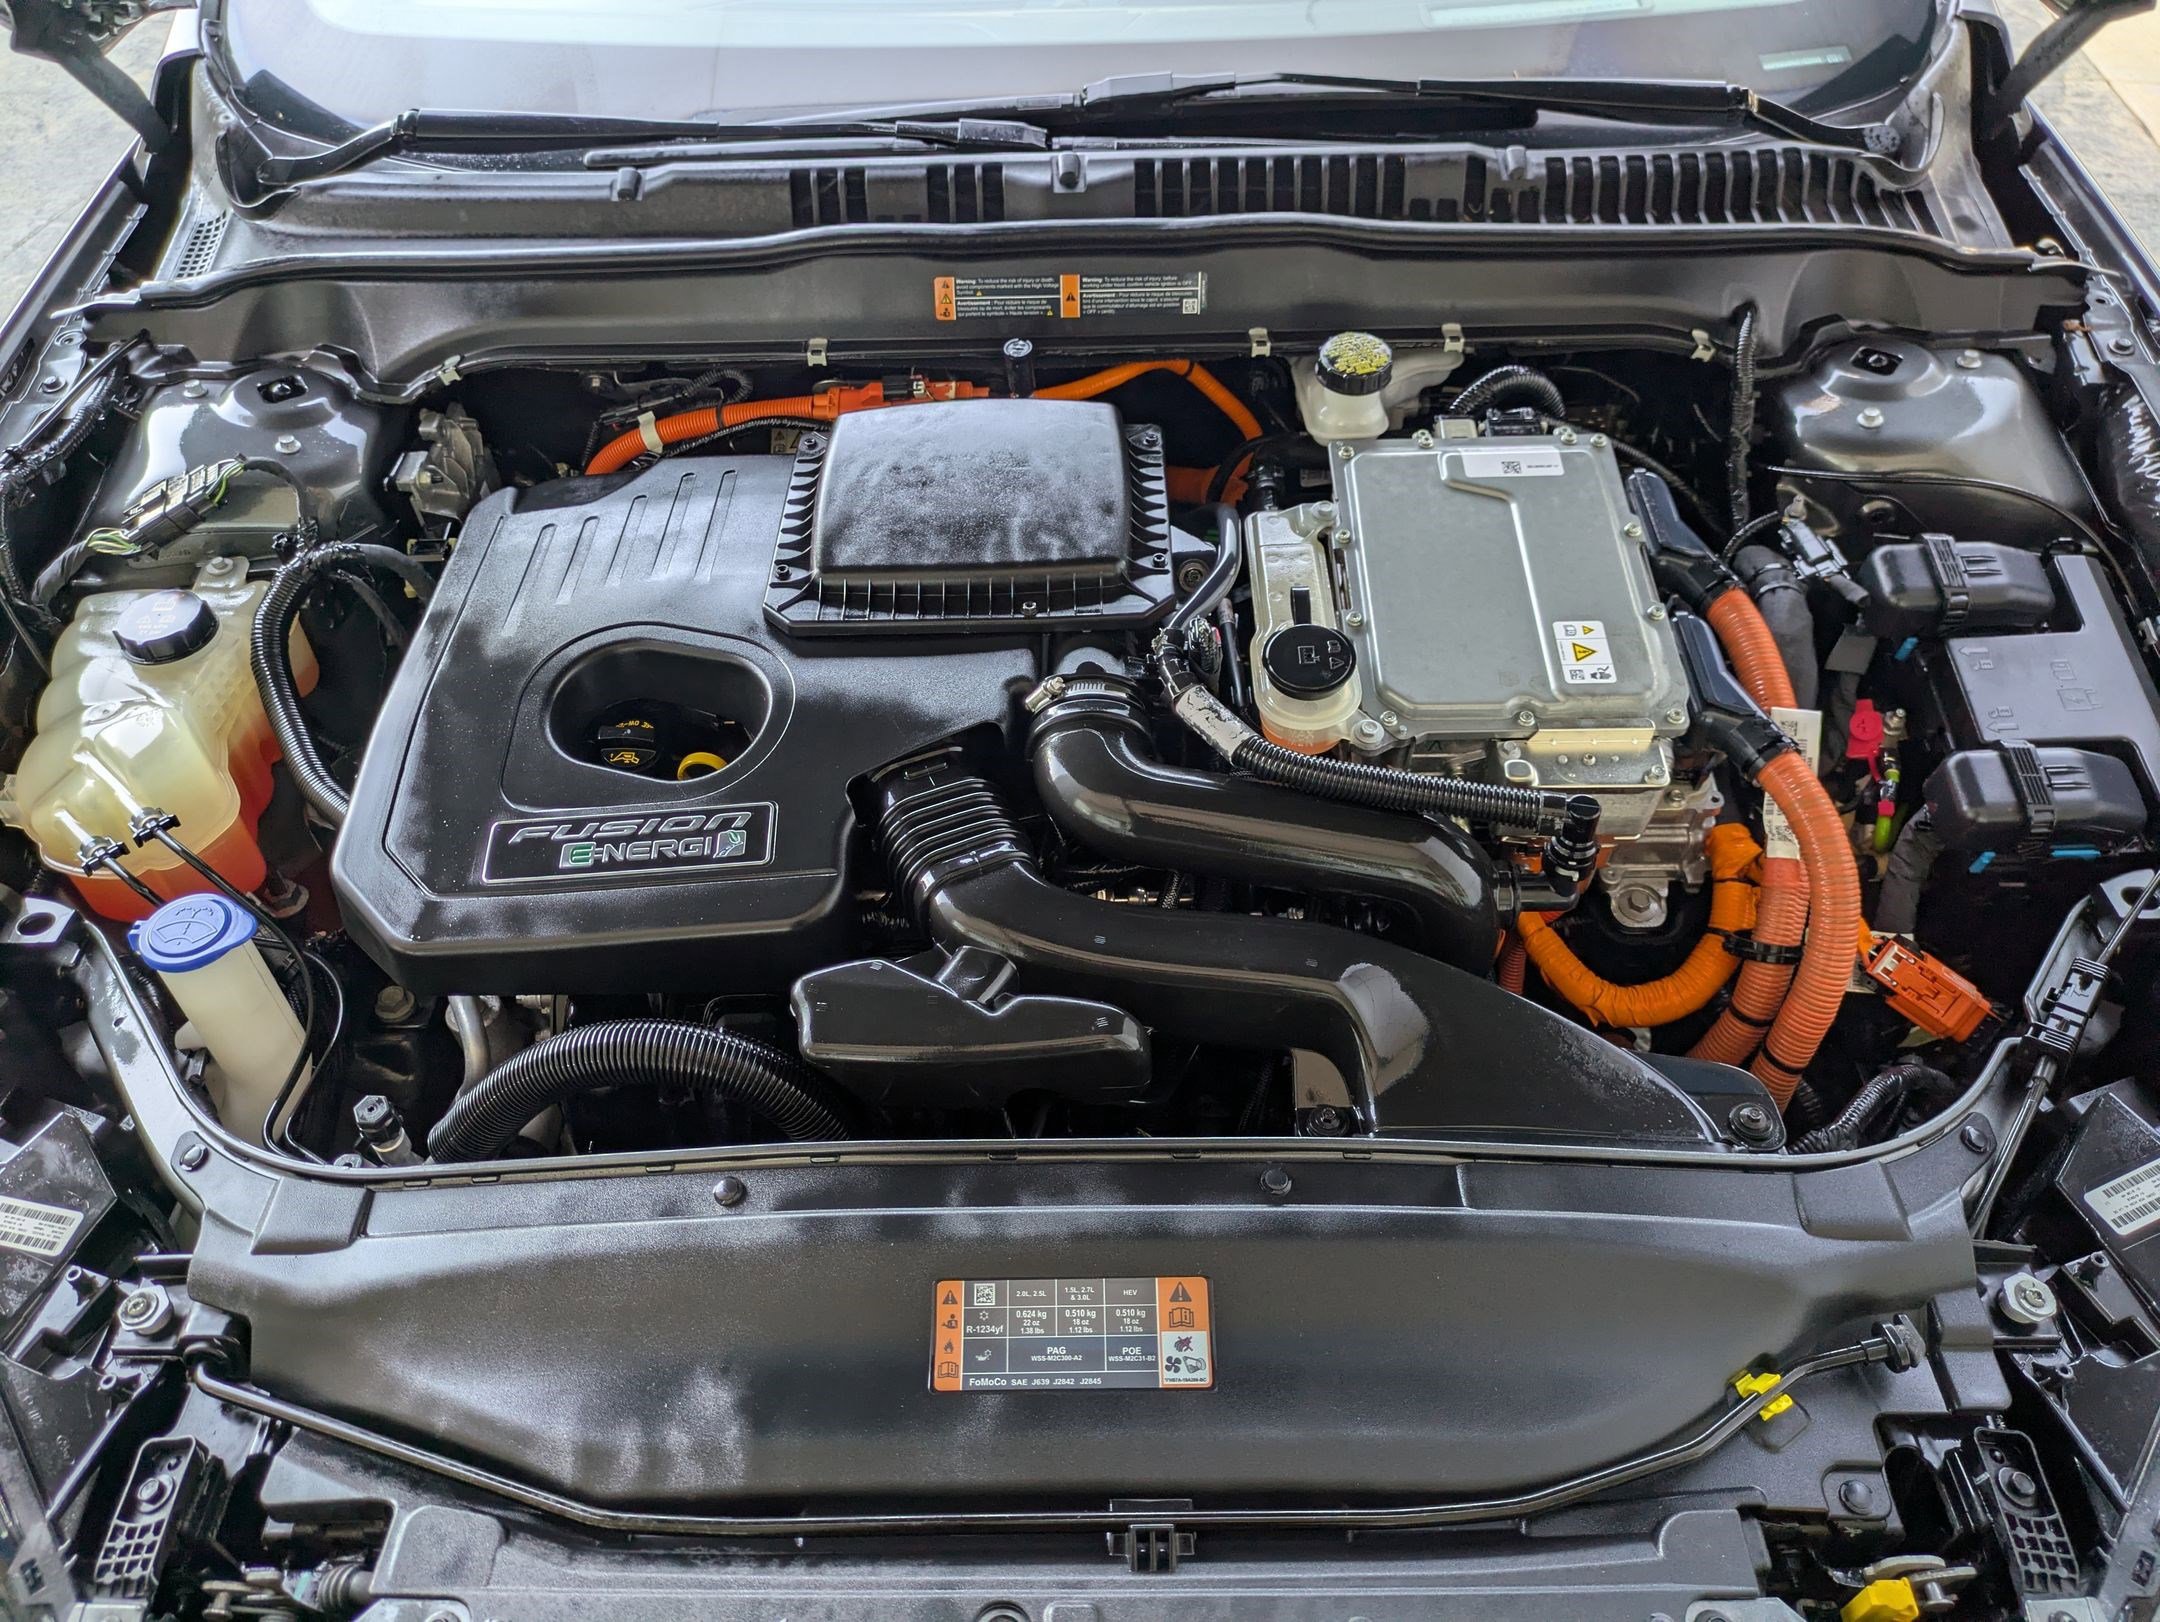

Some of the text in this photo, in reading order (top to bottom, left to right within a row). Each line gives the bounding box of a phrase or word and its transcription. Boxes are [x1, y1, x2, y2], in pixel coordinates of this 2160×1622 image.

[508, 812, 752, 844] FUSION
[1016, 1310, 1047, 1319] 0.624 kg
[1065, 1310, 1096, 1318] 0.510 kg
[1116, 1309, 1146, 1318] 0.510 kg
[966, 1325, 1004, 1334] R-1234yf
[1083, 1326, 1093, 1334] lbs
[1047, 1346, 1066, 1354] PAG
[1122, 1347, 1142, 1355] POE
[969, 1378, 1006, 1386] FoMoCo
